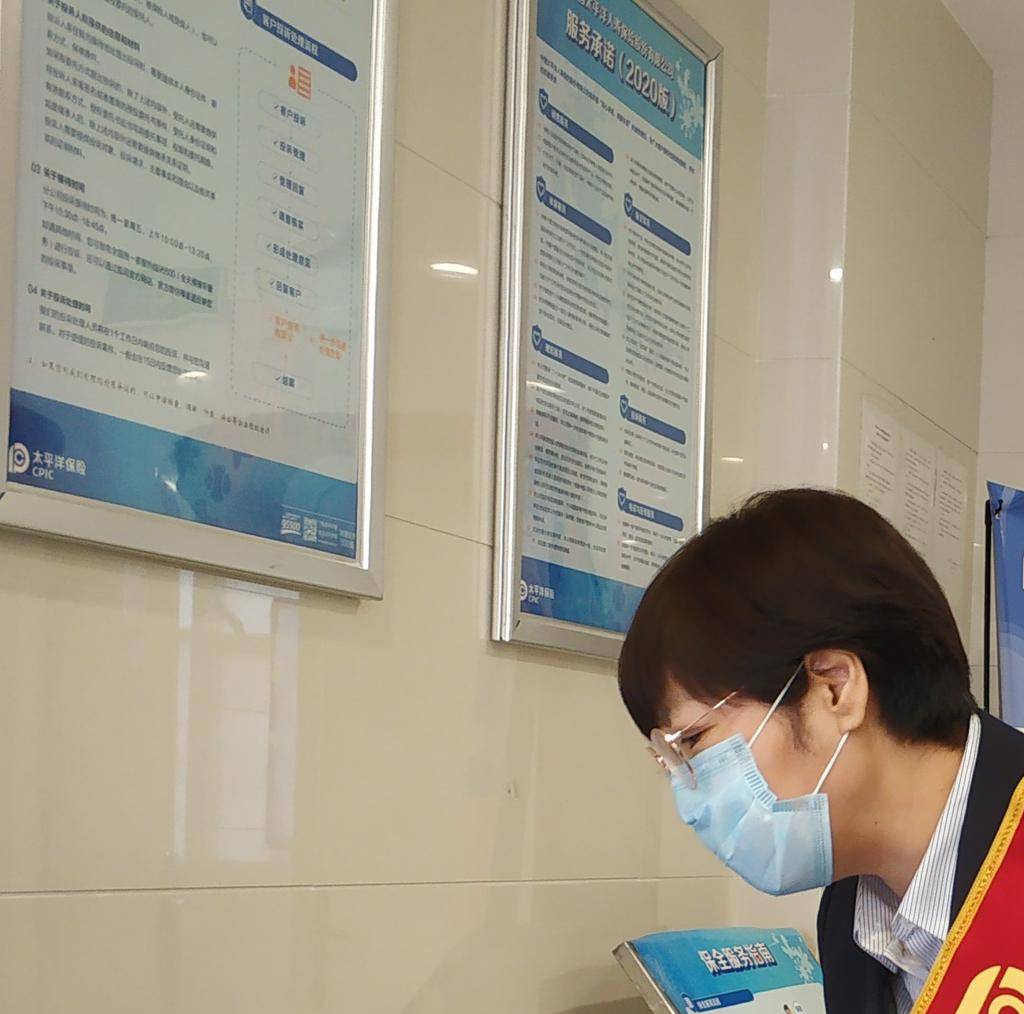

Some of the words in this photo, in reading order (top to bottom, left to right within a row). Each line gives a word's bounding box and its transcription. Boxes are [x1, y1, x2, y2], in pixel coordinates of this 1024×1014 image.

[31, 468, 54, 481] CPIC
[32, 450, 87, 477] 太平洋保险
[698, 942, 776, 974] 保全服务指南
